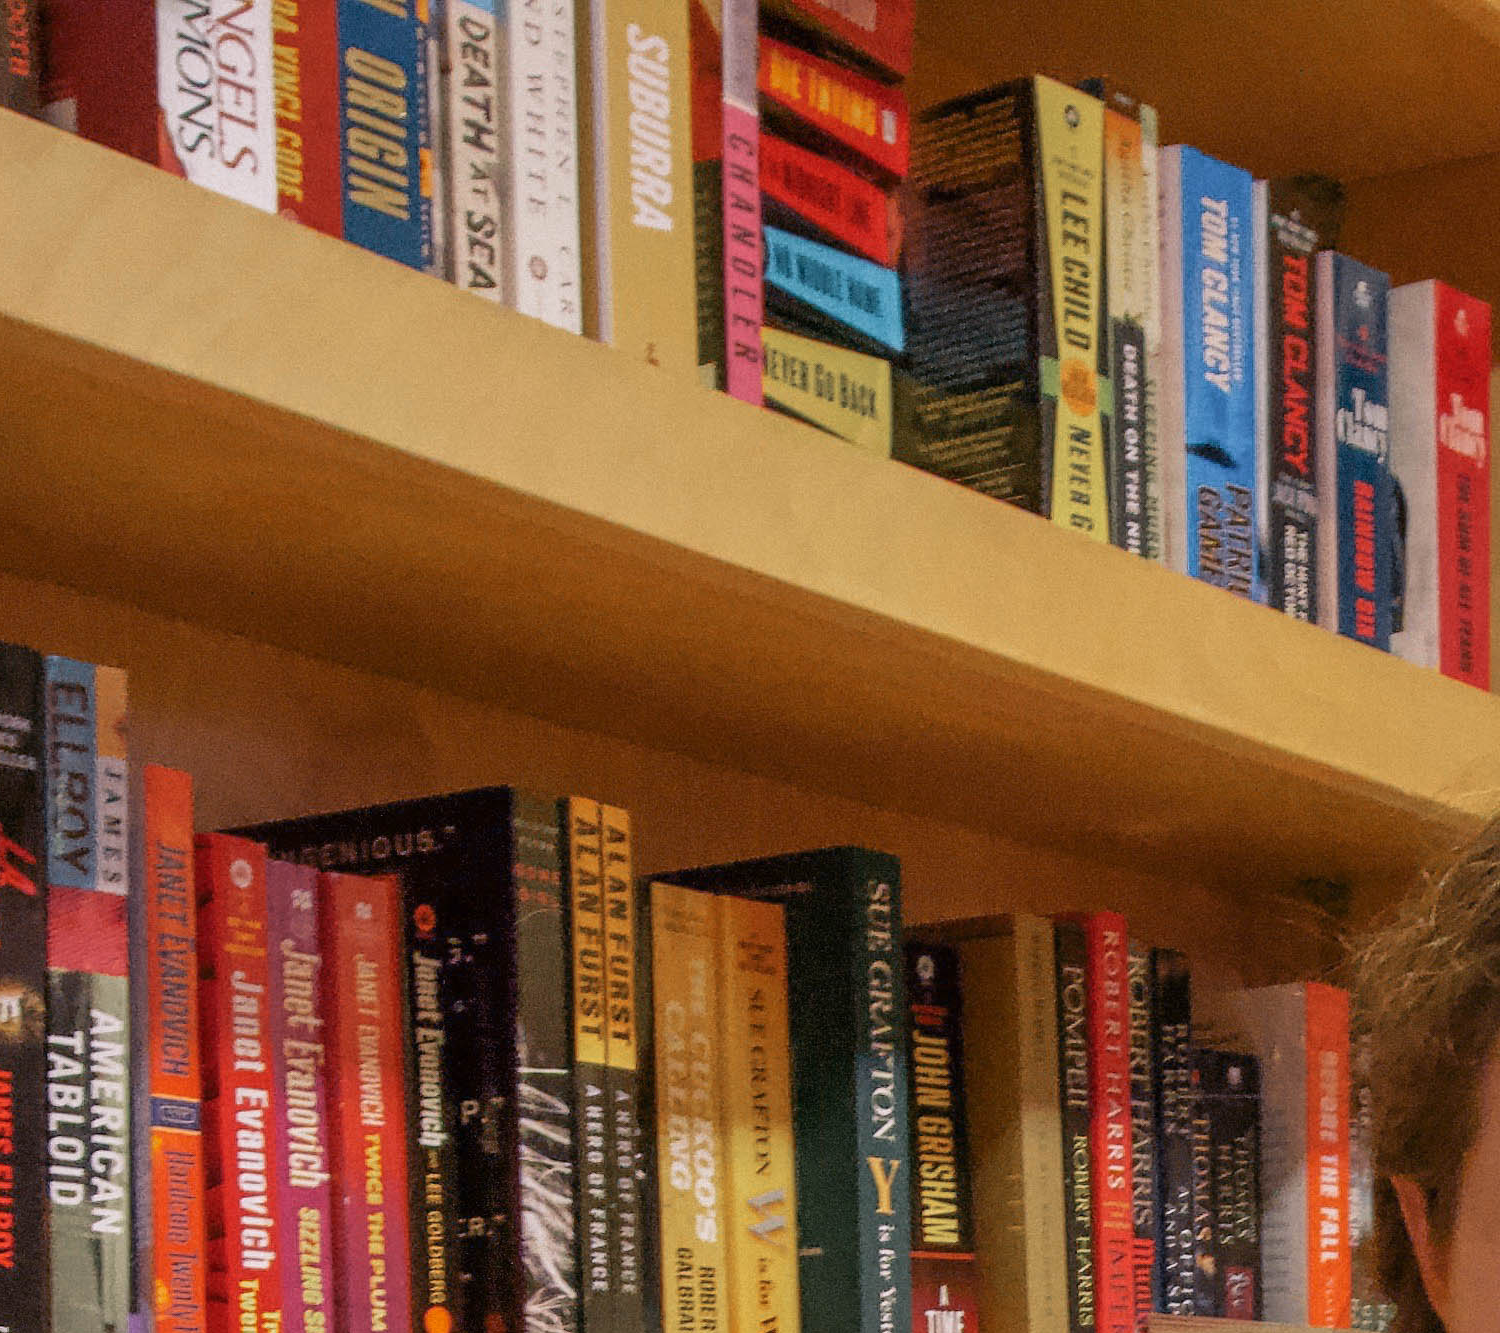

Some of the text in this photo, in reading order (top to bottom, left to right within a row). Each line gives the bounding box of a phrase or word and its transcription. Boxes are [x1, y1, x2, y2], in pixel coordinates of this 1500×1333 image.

[345, 45, 409, 222] ORIGIN
[456, 16, 500, 291] DEATH AT SEA
[625, 22, 675, 233] SUBURRA
[729, 134, 759, 364] CHANDLER
[1061, 191, 1092, 352] LEE CHILD
[1202, 194, 1234, 394] TOM CLANCY
[50, 679, 90, 878] ELLROY
[868, 880, 891, 951] SUE
[48, 1032, 83, 1208] TABLOID
[90, 1008, 125, 1237] AMERICAN
[232, 970, 274, 1271] Janet Evanovich
[866, 959, 897, 1145] GRAFTON
[912, 1028, 958, 1245] JOHN GRISHAM
[866, 1155, 901, 1216] Y
